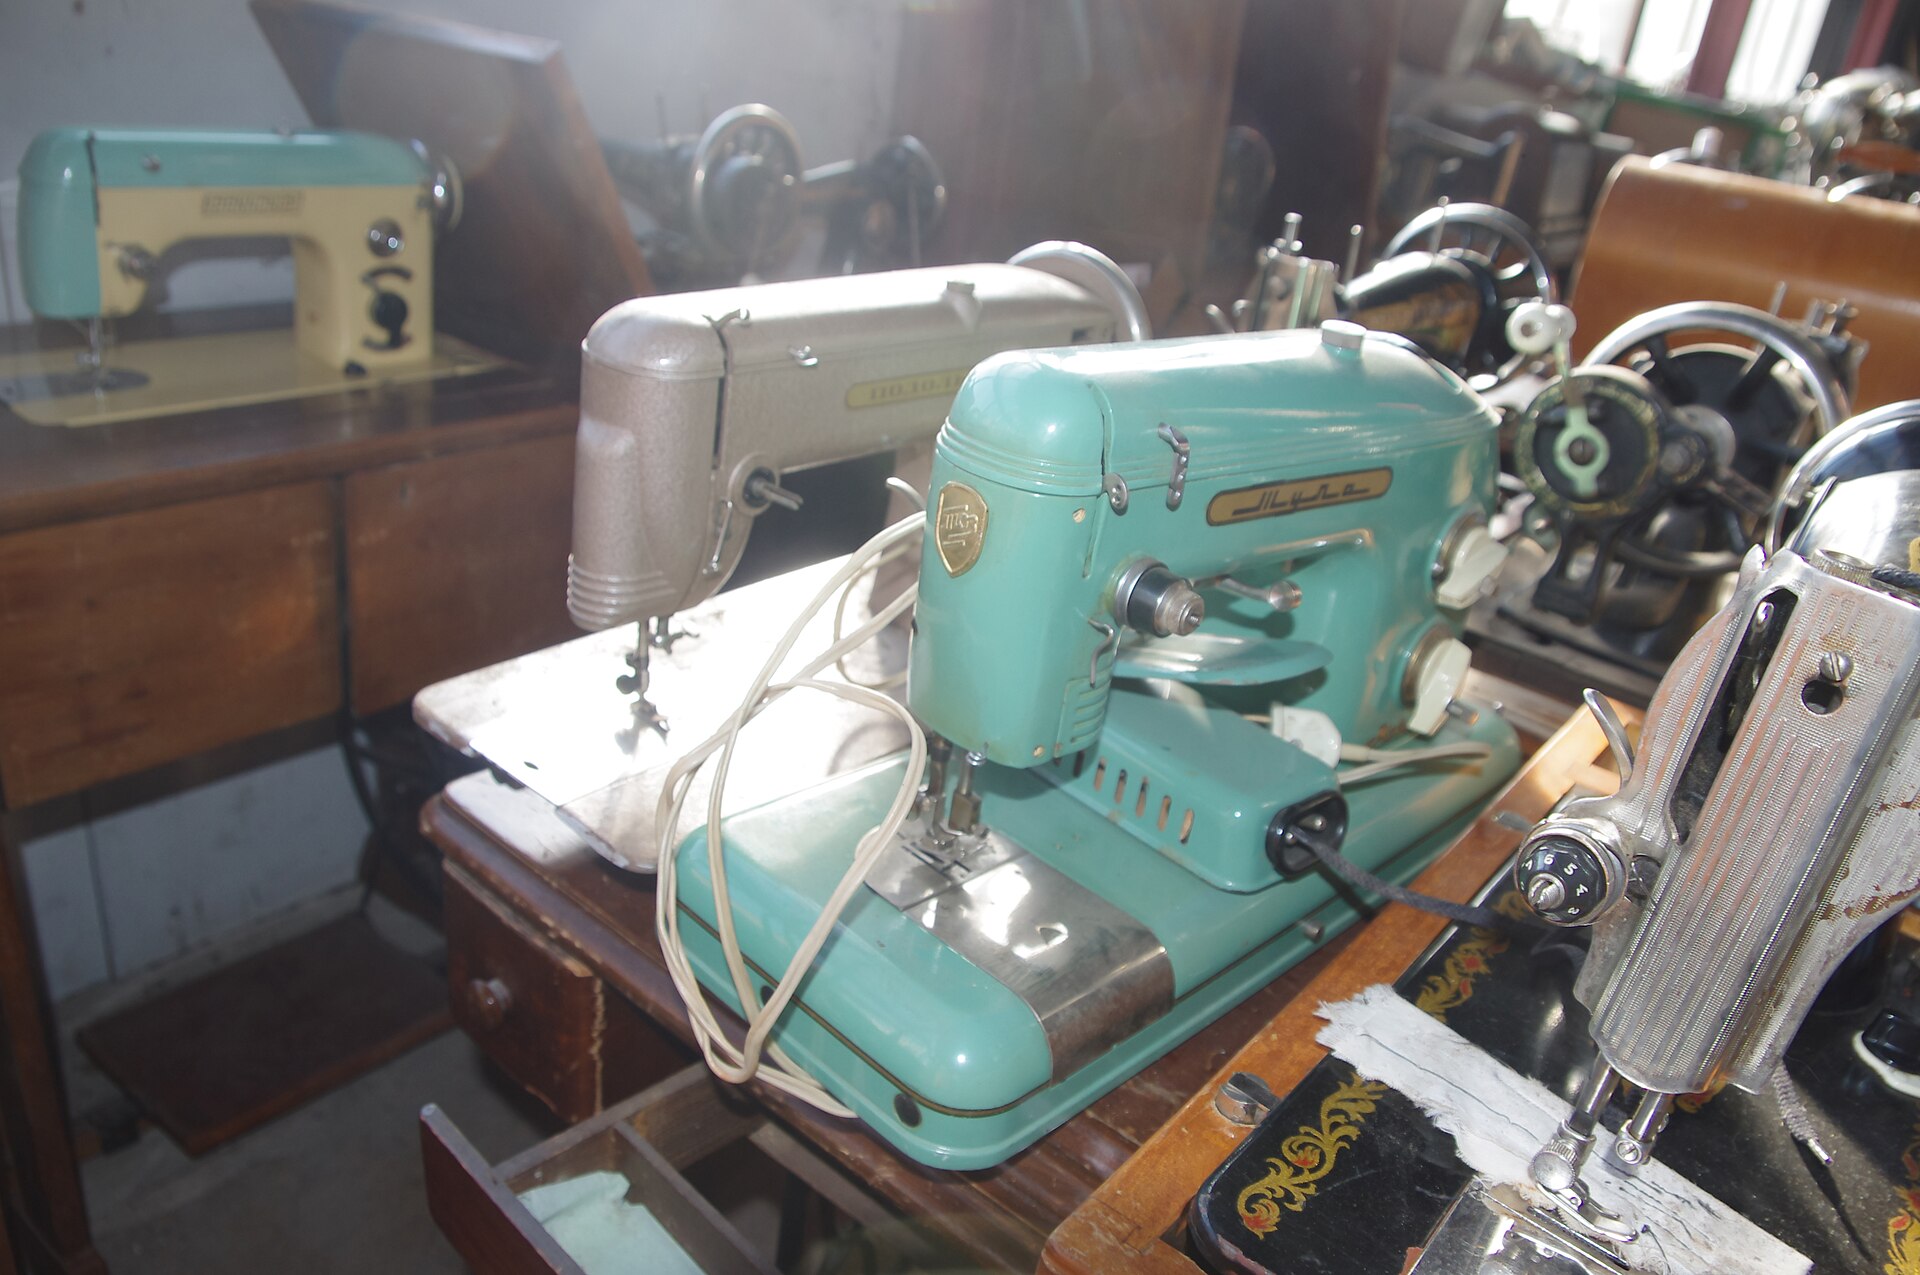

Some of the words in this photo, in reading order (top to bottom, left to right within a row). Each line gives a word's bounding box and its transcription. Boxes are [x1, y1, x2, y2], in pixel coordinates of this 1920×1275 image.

[1543, 854, 1555, 865] 6
[1563, 862, 1578, 876] 5
[1576, 884, 1589, 897] 4
